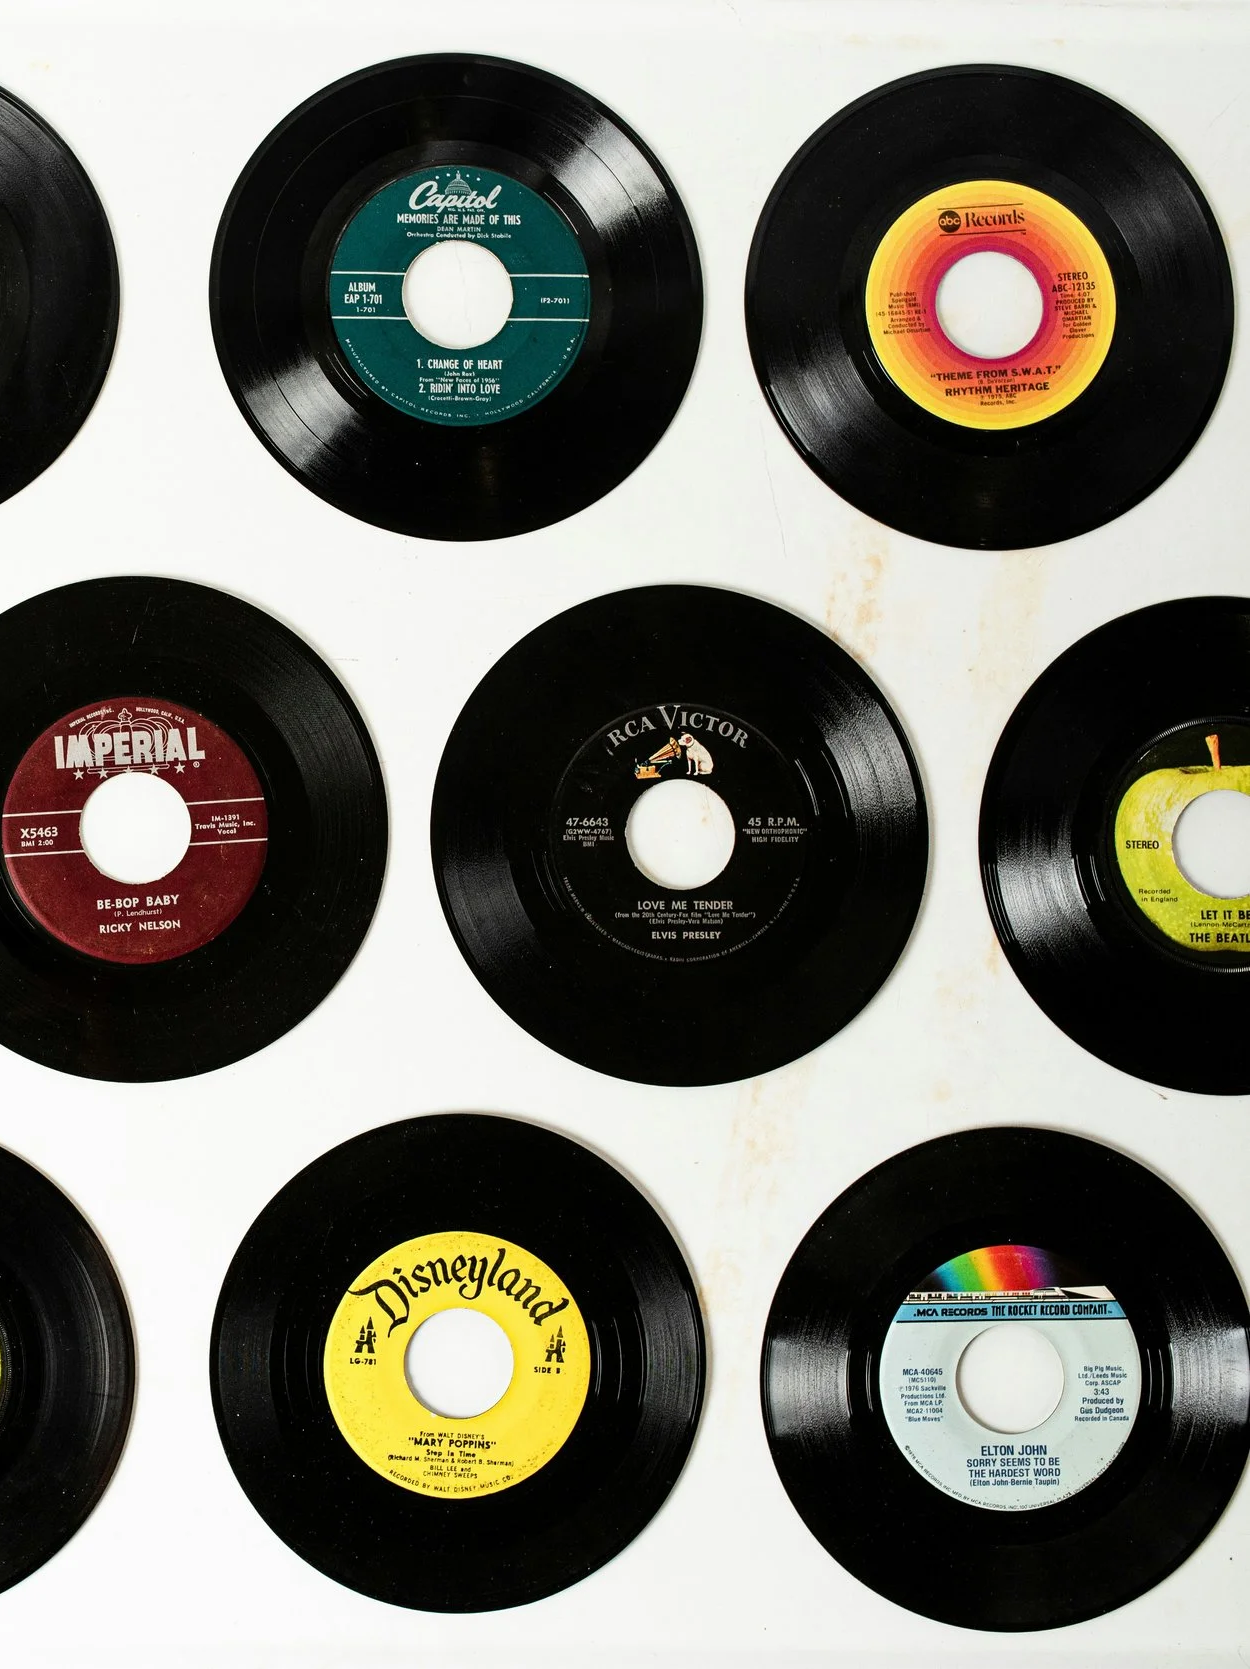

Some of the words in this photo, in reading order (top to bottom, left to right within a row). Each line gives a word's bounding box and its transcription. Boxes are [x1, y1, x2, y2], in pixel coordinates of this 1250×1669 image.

[408, 180, 502, 213] Capitol
[397, 214, 438, 224] MEMORIES
[443, 215, 458, 224] ARE
[463, 215, 484, 225] MADE
[489, 215, 499, 225] OF
[504, 215, 521, 225] THIS
[939, 215, 961, 226] abc
[965, 210, 1025, 228] Records
[1058, 272, 1088, 281] STEREO
[349, 282, 376, 292] ALBUM
[1052, 282, 1095, 293] ABC-12135
[344, 294, 360, 304] EAP
[363, 294, 382, 304] 1-701
[417, 358, 423, 369] 1.
[428, 359, 459, 369] CHANGE
[463, 360, 474, 369] OF
[478, 359, 502, 369] HEART
[930, 371, 973, 382] "THEME
[977, 369, 1008, 378] FROM
[1011, 365, 1061, 377] S.W.A.T."
[419, 383, 426, 393] 2.
[430, 383, 453, 394] RIDIN'
[458, 383, 476, 394] INTO
[481, 383, 500, 394] LOVE
[945, 385, 991, 397] RHYTHM
[995, 382, 1049, 394] HERITAGE
[607, 717, 656, 747] RCA
[657, 705, 749, 748] VICTOR
[54, 726, 205, 769] IMPERIAL
[566, 818, 608, 826] 47-6643
[21, 827, 58, 838] X5463
[1126, 841, 1159, 849] STEREO
[97, 898, 139, 910] BE-BOP
[146, 895, 179, 907] BABY
[638, 901, 665, 910] LOVE
[671, 901, 687, 910] ME
[693, 901, 733, 910] TENDER
[1201, 911, 1218, 920] LET
[1223, 910, 1232, 920] IT
[1239, 910, 1250, 920] BE
[99, 923, 132, 934] RICKY
[139, 920, 181, 931] NELSON
[651, 931, 677, 939] ELVIS
[682, 931, 721, 939] PRESLEY
[1190, 933, 1210, 943] THE
[348, 1248, 569, 1338] Disneyland
[913, 1308, 939, 1317] .MCA
[941, 1307, 987, 1316] RECORDS
[991, 1306, 1006, 1316] THE
[1008, 1305, 1038, 1316] ROCKET
[1040, 1304, 1071, 1315] RECORD
[1072, 1304, 1107, 1315] COMPANY
[409, 1437, 443, 1447] "MARY
[449, 1439, 496, 1449] POPPINS"
[426, 1449, 443, 1457] Step
[981, 1445, 1014, 1456] ELTON
[1018, 1445, 1047, 1455] JOHN
[967, 1458, 996, 1467] SORRY
[1000, 1458, 1030, 1467] SEEMS
[1034, 1458, 1046, 1466] TO
[1049, 1457, 1060, 1466] BE
[969, 1469, 986, 1478] THE
[989, 1468, 1030, 1477] HARDEST
[1034, 1468, 1060, 1477] WORD
